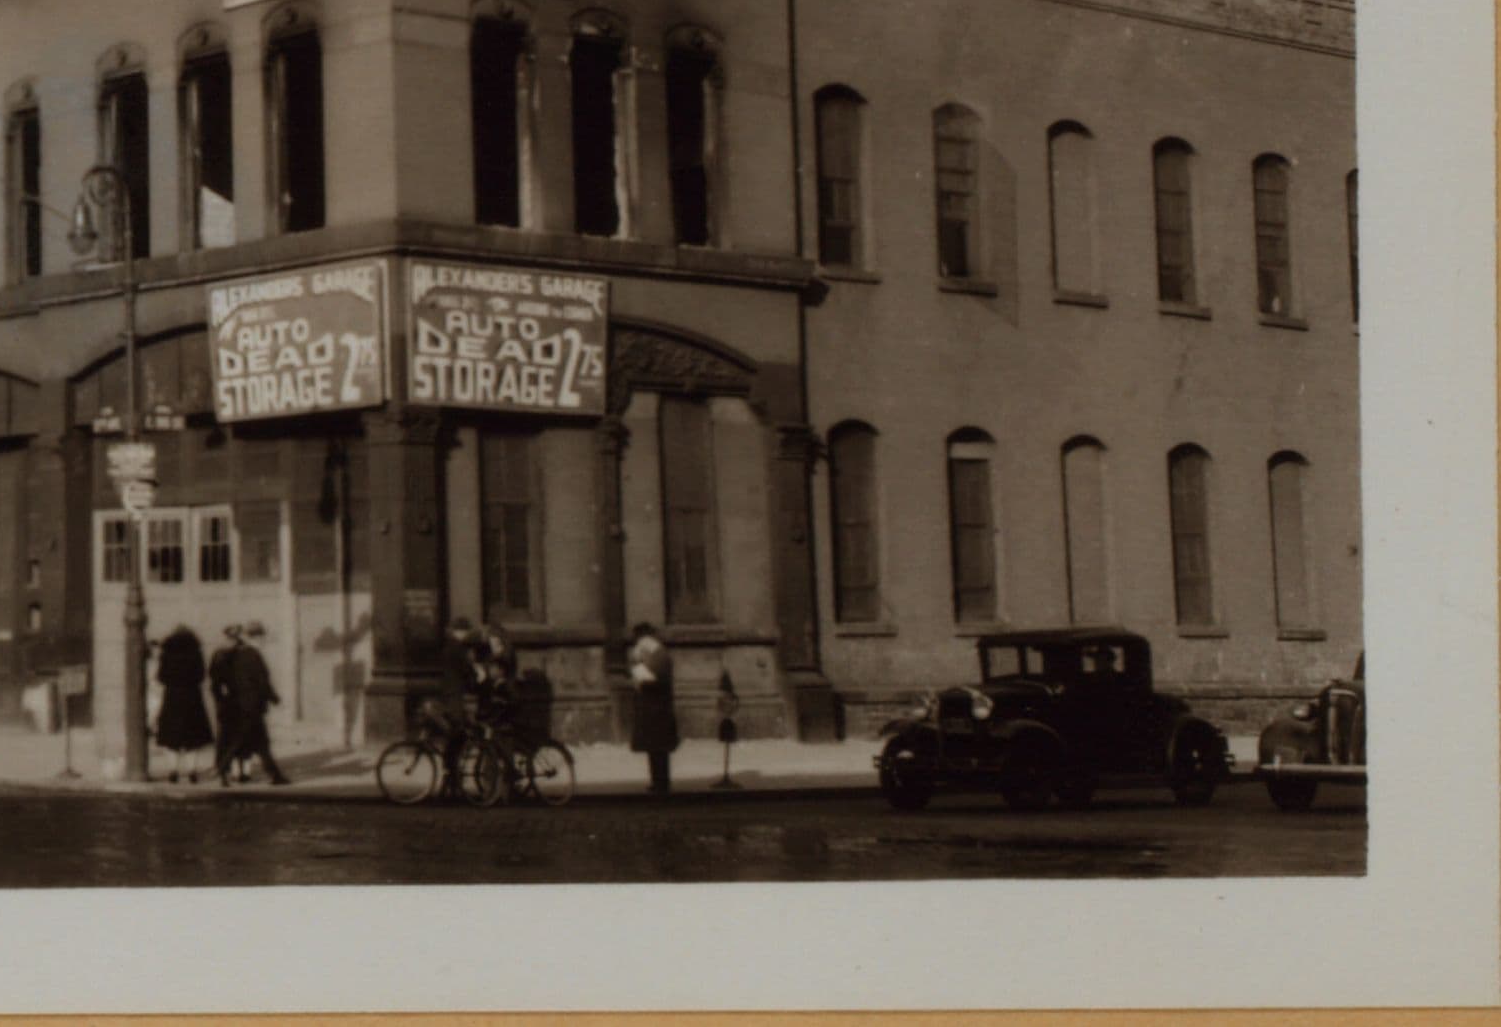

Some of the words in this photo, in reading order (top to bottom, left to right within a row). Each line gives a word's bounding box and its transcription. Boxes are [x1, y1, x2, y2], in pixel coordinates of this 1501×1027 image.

[540, 275, 605, 317] GARAGE
[236, 316, 310, 352] AUTO
[417, 316, 561, 366] DEAD
[445, 309, 540, 341] AUTO
[218, 332, 335, 377] DEAD
[217, 365, 335, 416] STORAGE
[413, 355, 556, 406] STORAGE
